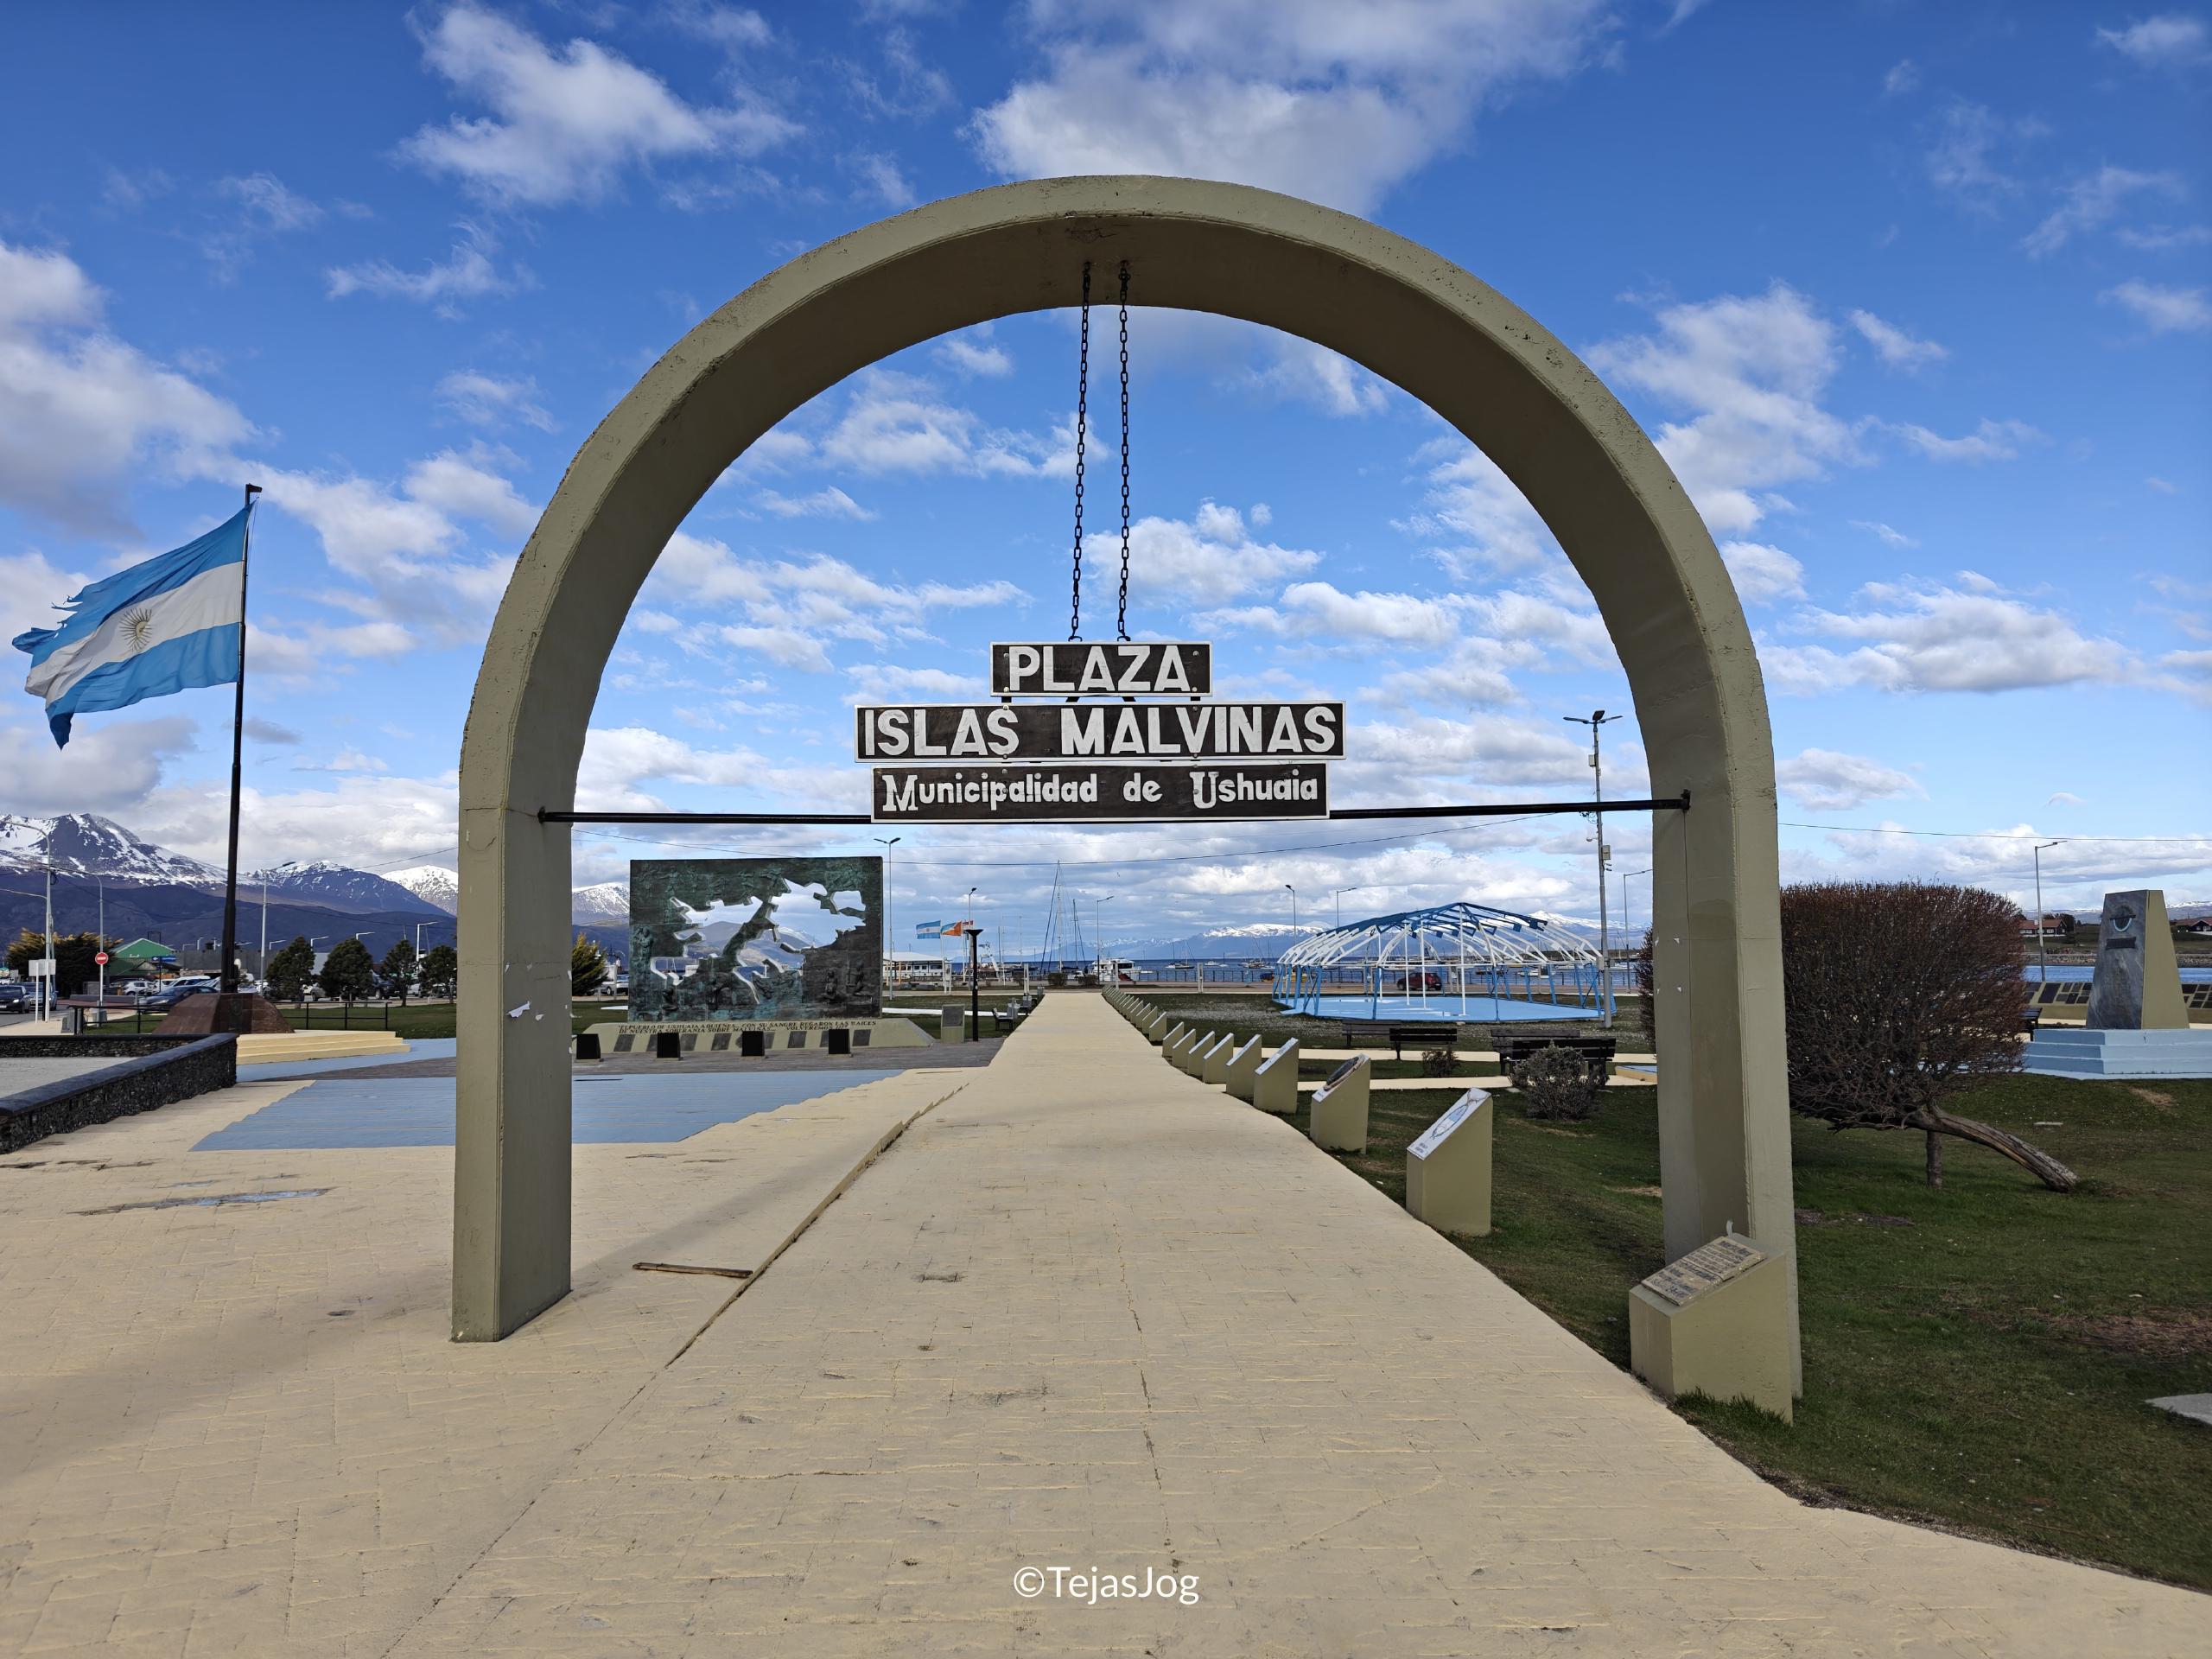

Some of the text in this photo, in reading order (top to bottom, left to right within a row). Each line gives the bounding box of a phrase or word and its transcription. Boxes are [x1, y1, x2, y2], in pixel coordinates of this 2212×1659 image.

[1008, 645, 1191, 691] PLAZA
[865, 706, 1336, 756] ISLAS MALVINAS
[882, 769, 1318, 811] Municipalidad de Ushuaia
